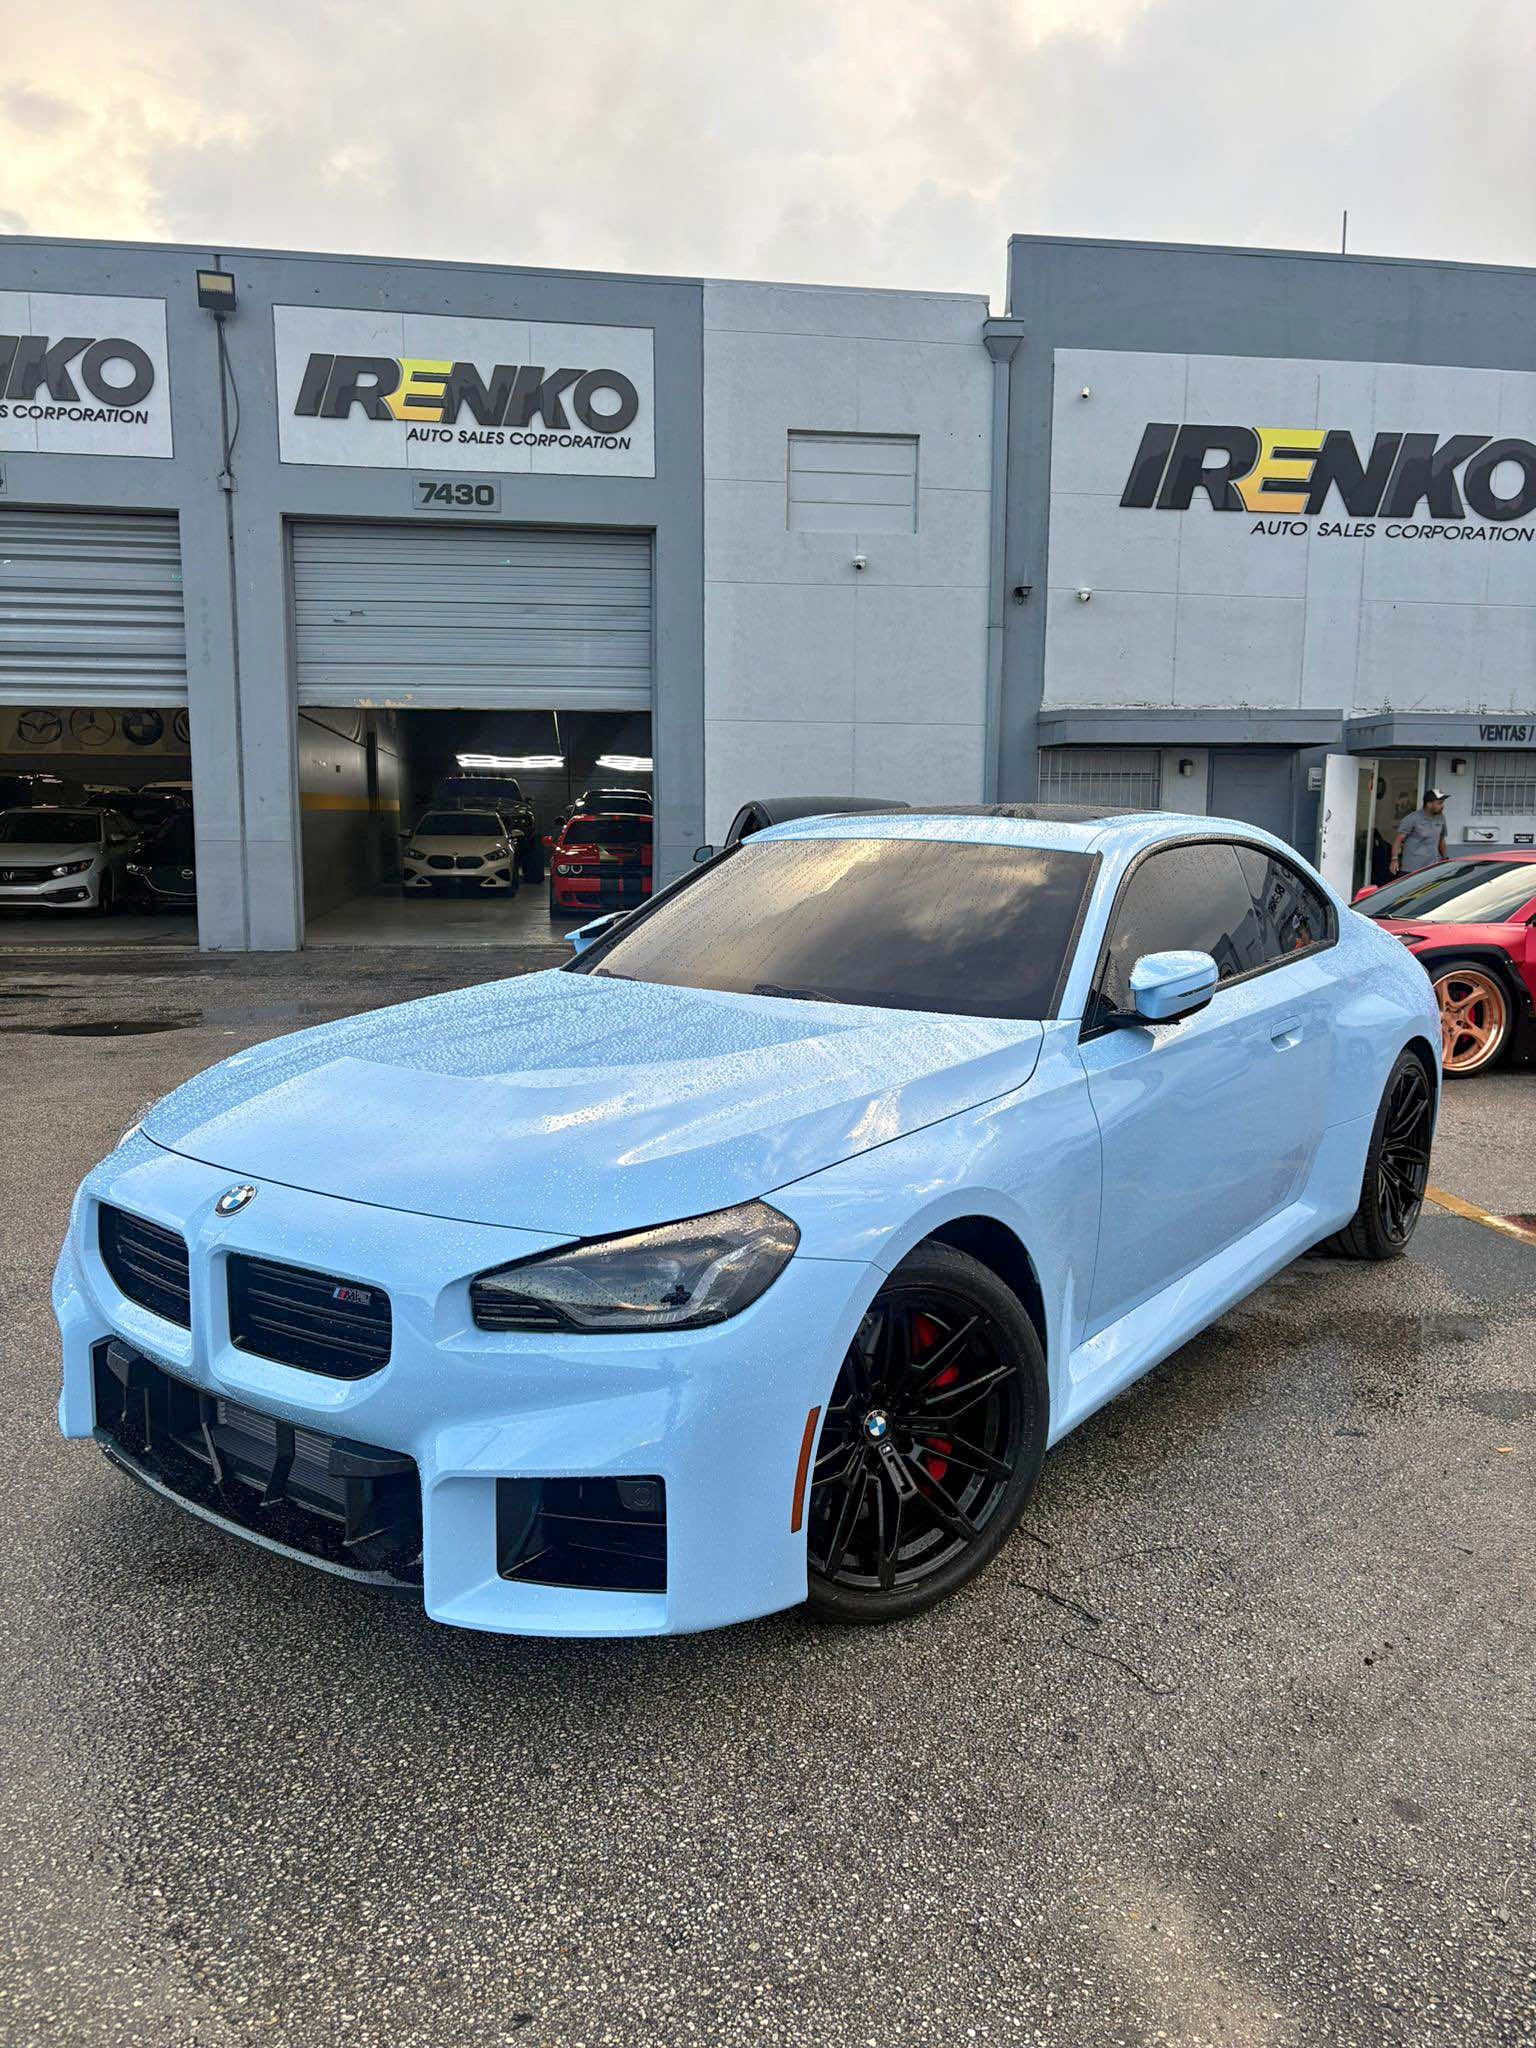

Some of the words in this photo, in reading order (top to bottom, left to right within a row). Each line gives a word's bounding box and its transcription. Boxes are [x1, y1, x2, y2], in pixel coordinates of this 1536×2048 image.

[0, 334, 155, 407] KO
[294, 352, 639, 434] IRENKO
[13, 405, 149, 424] CORPORATION
[407, 428, 453, 443] AUTO
[458, 429, 505, 445] SALES
[509, 432, 631, 450] CORPORATION
[1119, 421, 1536, 522] IRENKO
[418, 482, 495, 506] 7430
[1250, 521, 1309, 536] AUTO
[1317, 523, 1376, 538] SALES
[1384, 524, 1536, 542] CORPORATION
[1479, 724, 1527, 742] VENTAS
